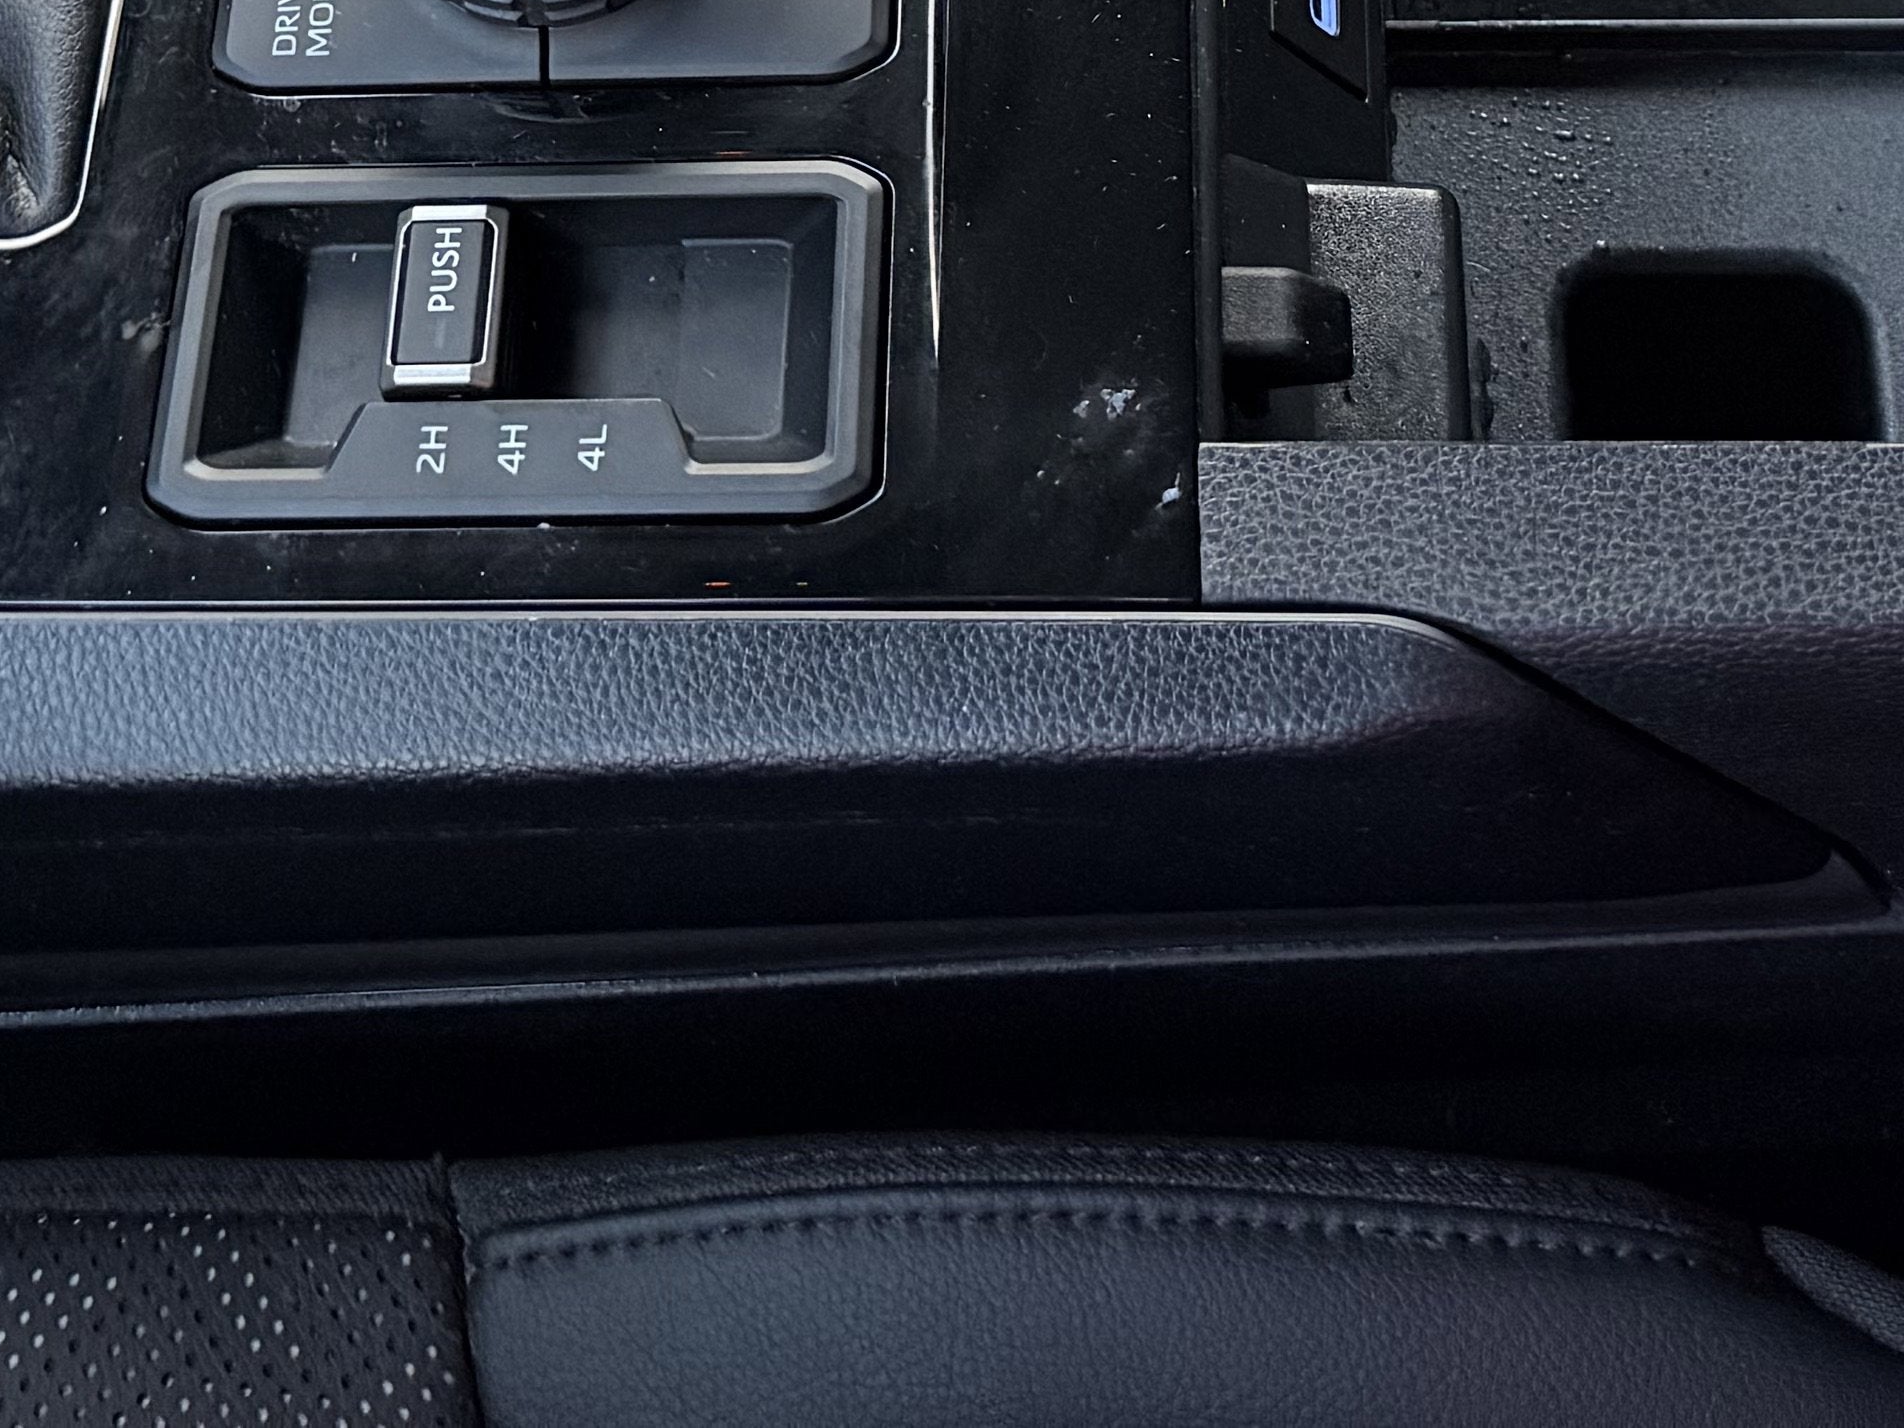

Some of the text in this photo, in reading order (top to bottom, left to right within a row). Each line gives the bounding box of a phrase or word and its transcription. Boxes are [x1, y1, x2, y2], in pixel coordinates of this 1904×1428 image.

[427, 227, 463, 312] PUSH
[416, 425, 448, 474] 2H
[497, 424, 528, 475] 4H
[577, 423, 607, 471] 4L
